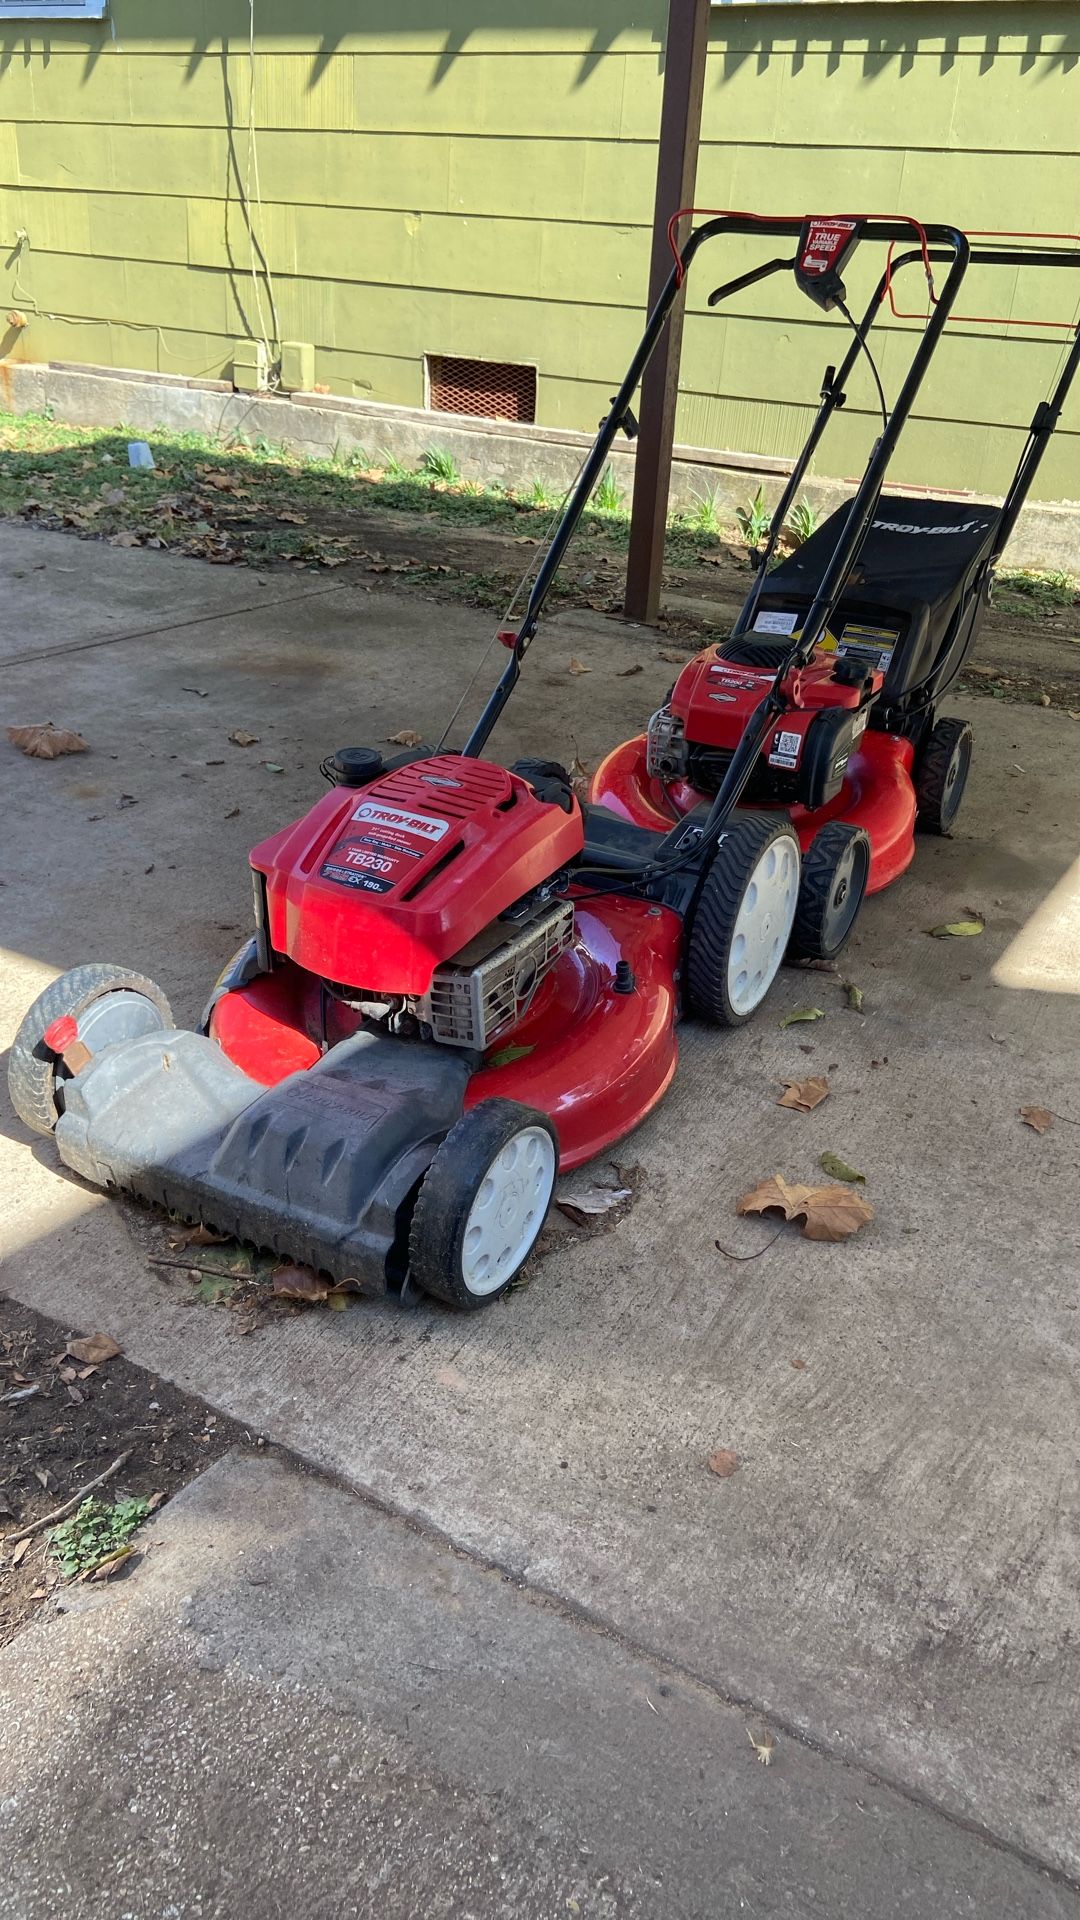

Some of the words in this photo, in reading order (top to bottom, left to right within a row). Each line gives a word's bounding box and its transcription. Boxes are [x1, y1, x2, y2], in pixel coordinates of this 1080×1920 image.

[815, 232, 841, 241] TRUE
[871, 520, 975, 534] TROY-BILT
[371, 810, 441, 834] TROY-BILT
[345, 851, 392, 872] TB230
